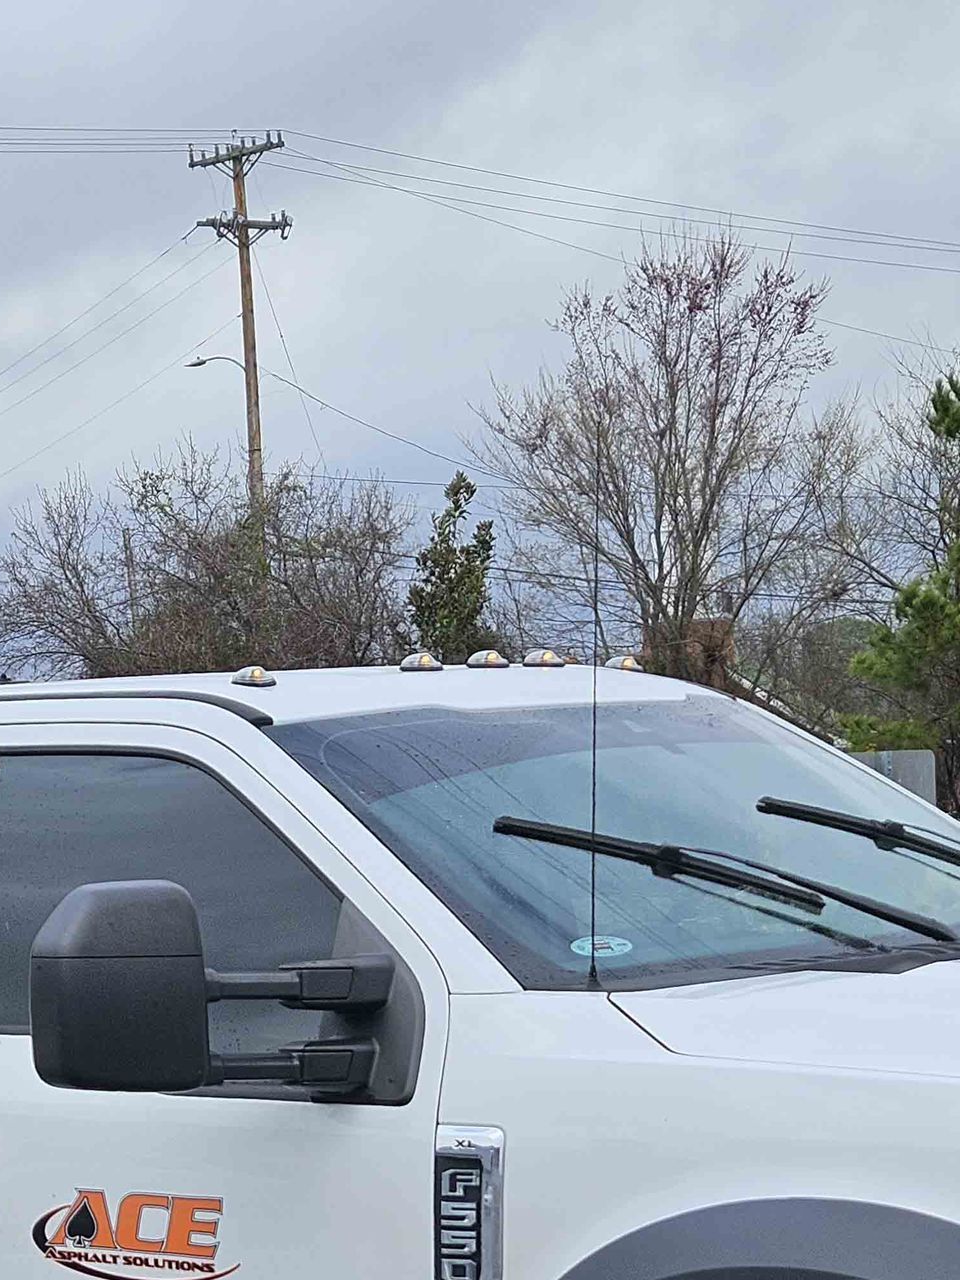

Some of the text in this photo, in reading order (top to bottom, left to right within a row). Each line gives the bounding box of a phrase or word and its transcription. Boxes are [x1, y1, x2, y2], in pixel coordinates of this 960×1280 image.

[455, 1139, 475, 1148] XL
[45, 1188, 224, 1260] ACE
[45, 1249, 216, 1273] ASPHALT SOLUTIONS
